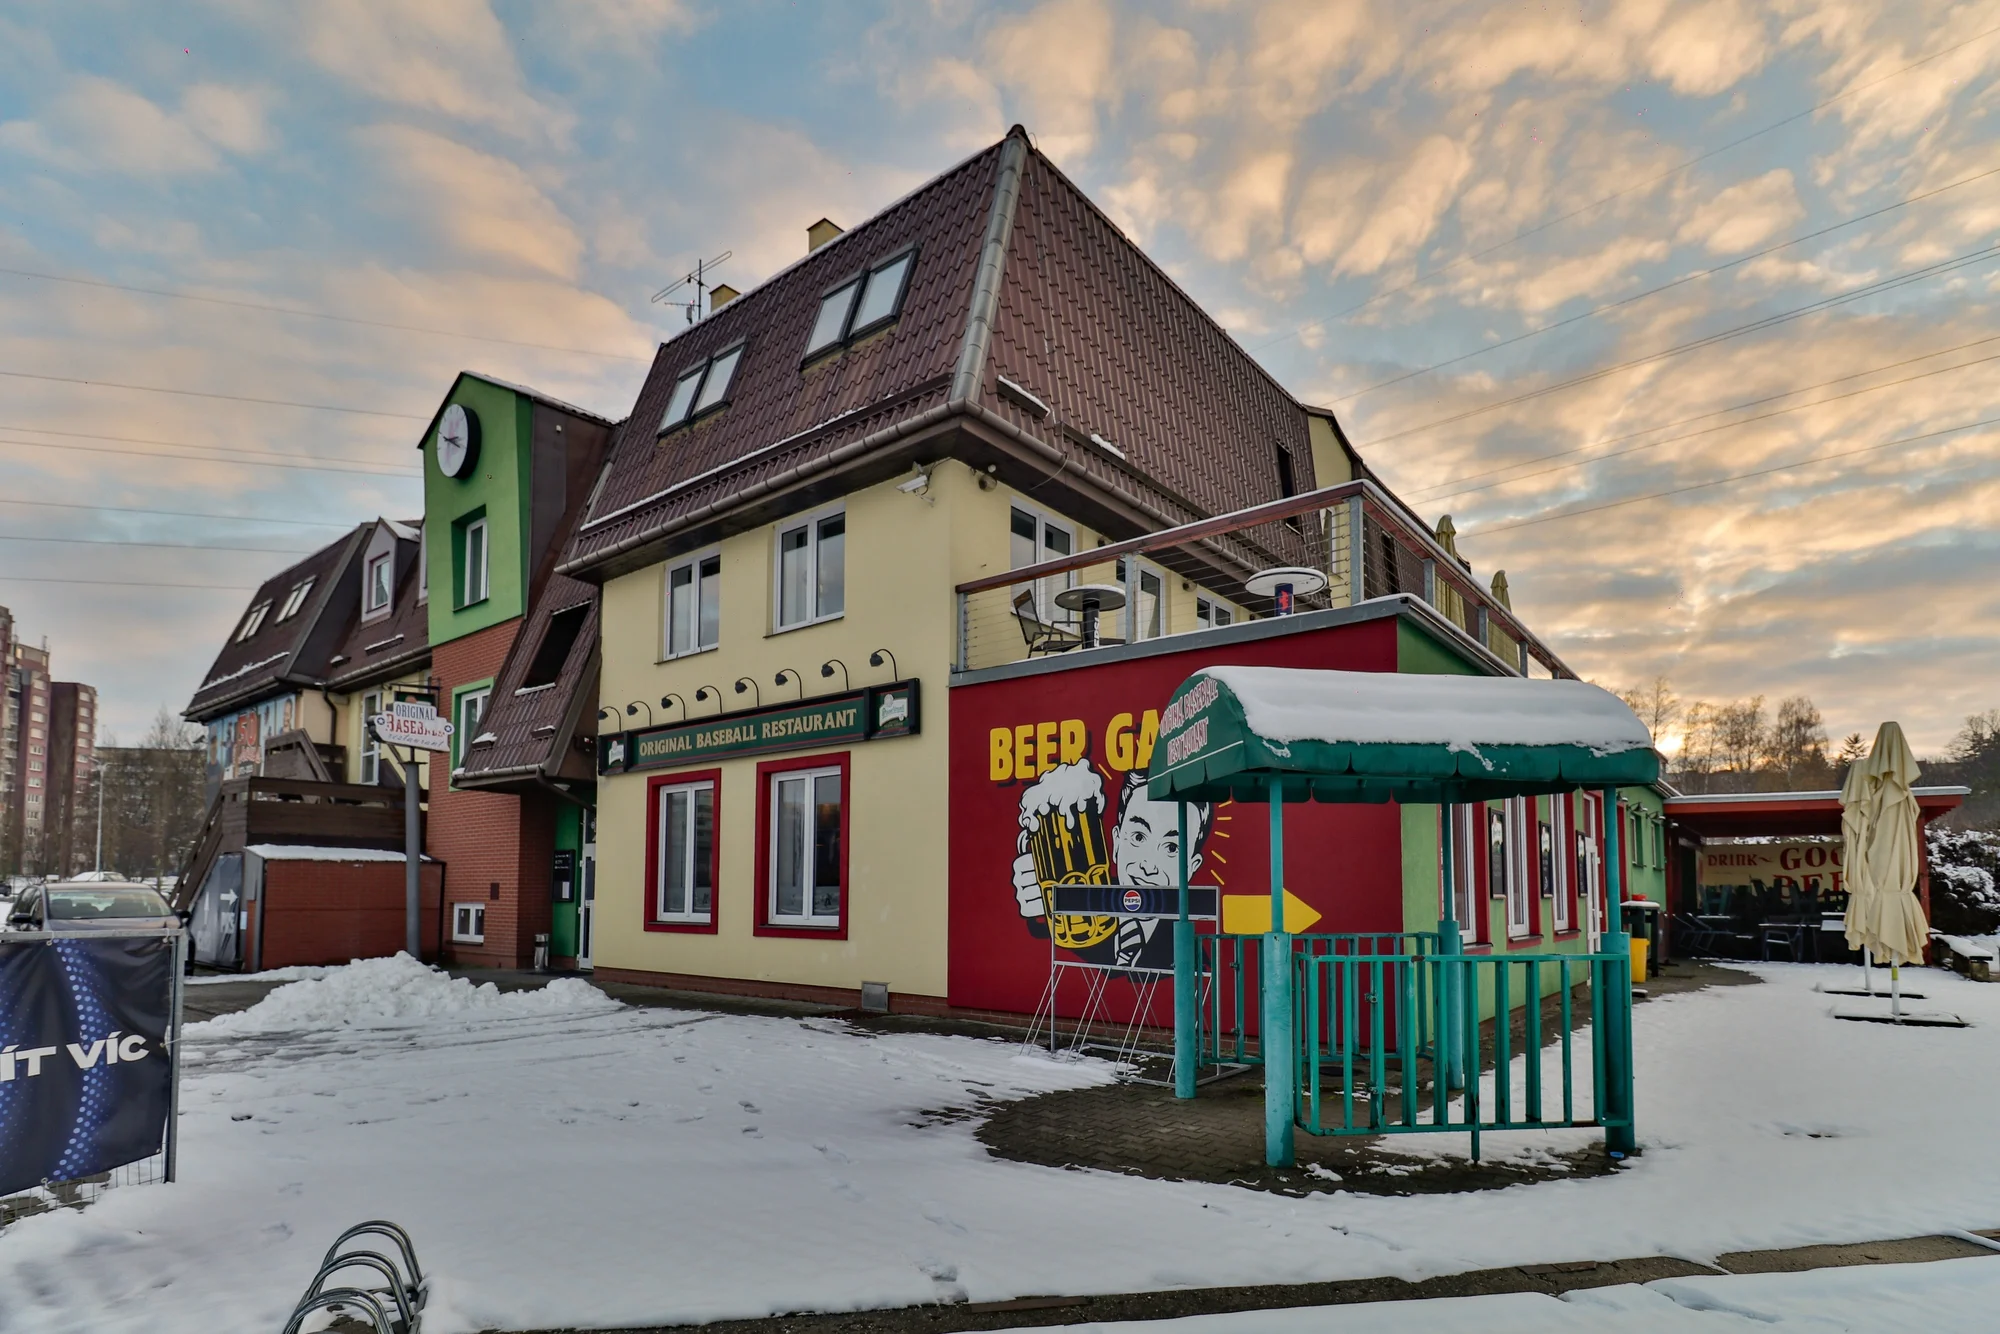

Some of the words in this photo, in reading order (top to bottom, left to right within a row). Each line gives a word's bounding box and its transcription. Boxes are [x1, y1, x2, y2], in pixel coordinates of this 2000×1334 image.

[385, 713, 446, 738] BASEB
[395, 704, 435, 721] ORIGINAL
[639, 735, 692, 757] ORIGINAL
[696, 724, 757, 749] BASEBALL
[761, 708, 857, 739] RESTAURANT
[989, 718, 1086, 781] BEER
[1104, 709, 1160, 772] GA
[1707, 853, 1758, 867] DRINK
[66, 1031, 150, 1070] VÍC
